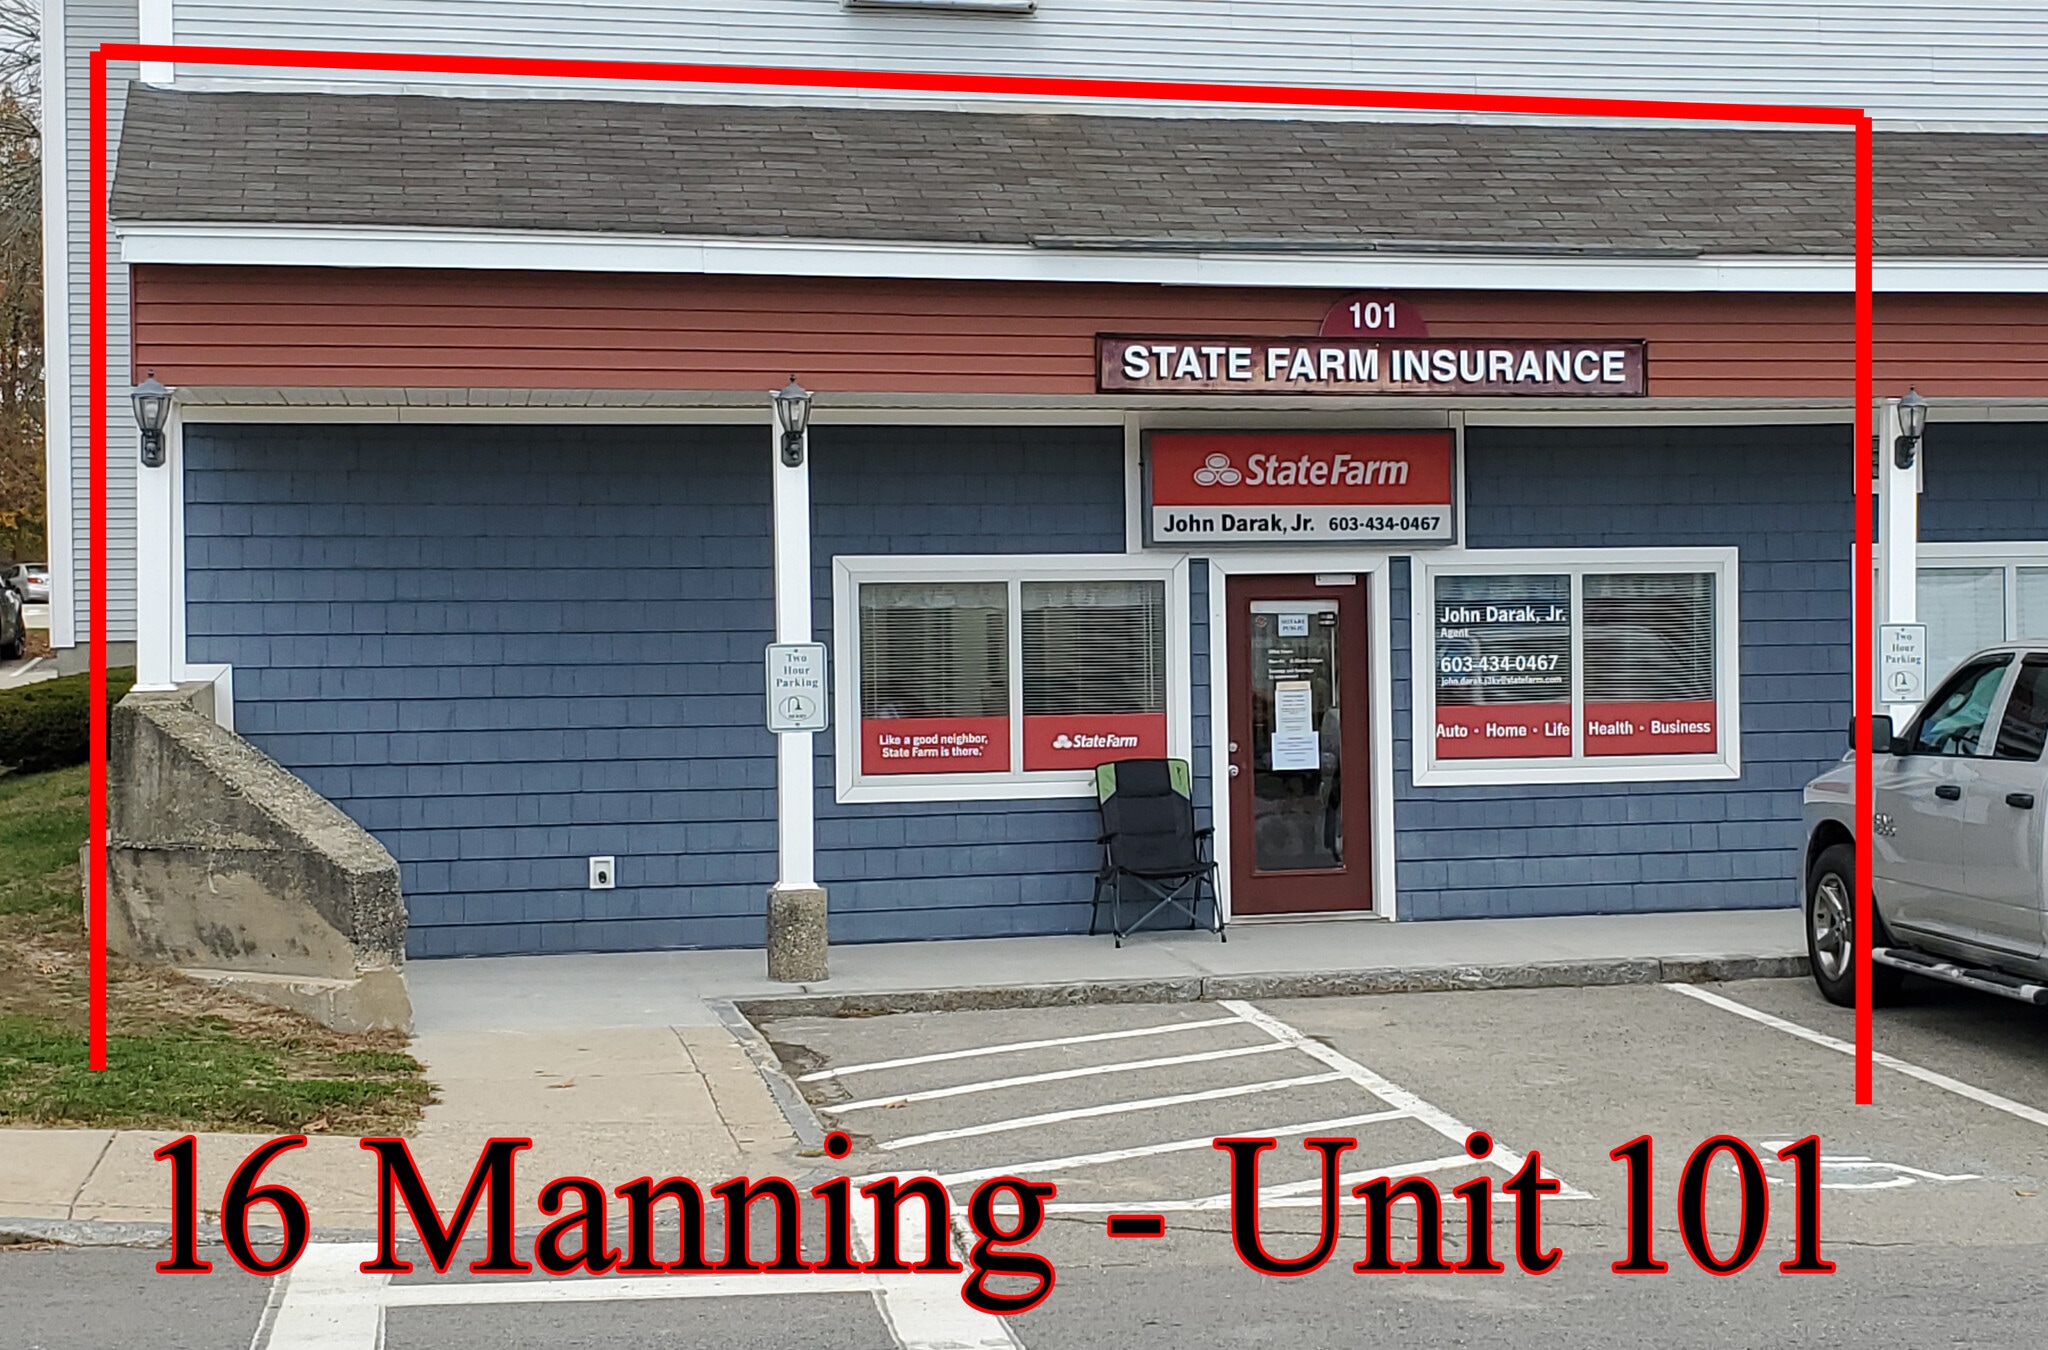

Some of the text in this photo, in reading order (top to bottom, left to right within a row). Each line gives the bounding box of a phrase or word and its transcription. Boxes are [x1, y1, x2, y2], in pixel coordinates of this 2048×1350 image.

[1349, 302, 1396, 329] 101
[1122, 345, 1627, 383] STATE FARM INSURANCE
[1163, 513, 1441, 535] John Darak, Jr. 603-434-0467
[1440, 604, 1567, 624] John Darak, Jr.
[1440, 627, 1470, 638] Agent
[1895, 632, 1913, 641] Two
[1891, 643, 1915, 652] Hour
[785, 653, 808, 663] Two
[1440, 654, 1559, 672] 603-434-0467
[1885, 654, 1922, 665] Parking
[783, 665, 811, 675] Hour
[776, 677, 819, 688] Parking
[1436, 719, 1712, 738] Auto Home Life Health Business
[879, 733, 989, 746] Like a good neighbor,
[881, 747, 910, 758] State
[911, 747, 938, 758] Farm
[940, 746, 950, 757] is
